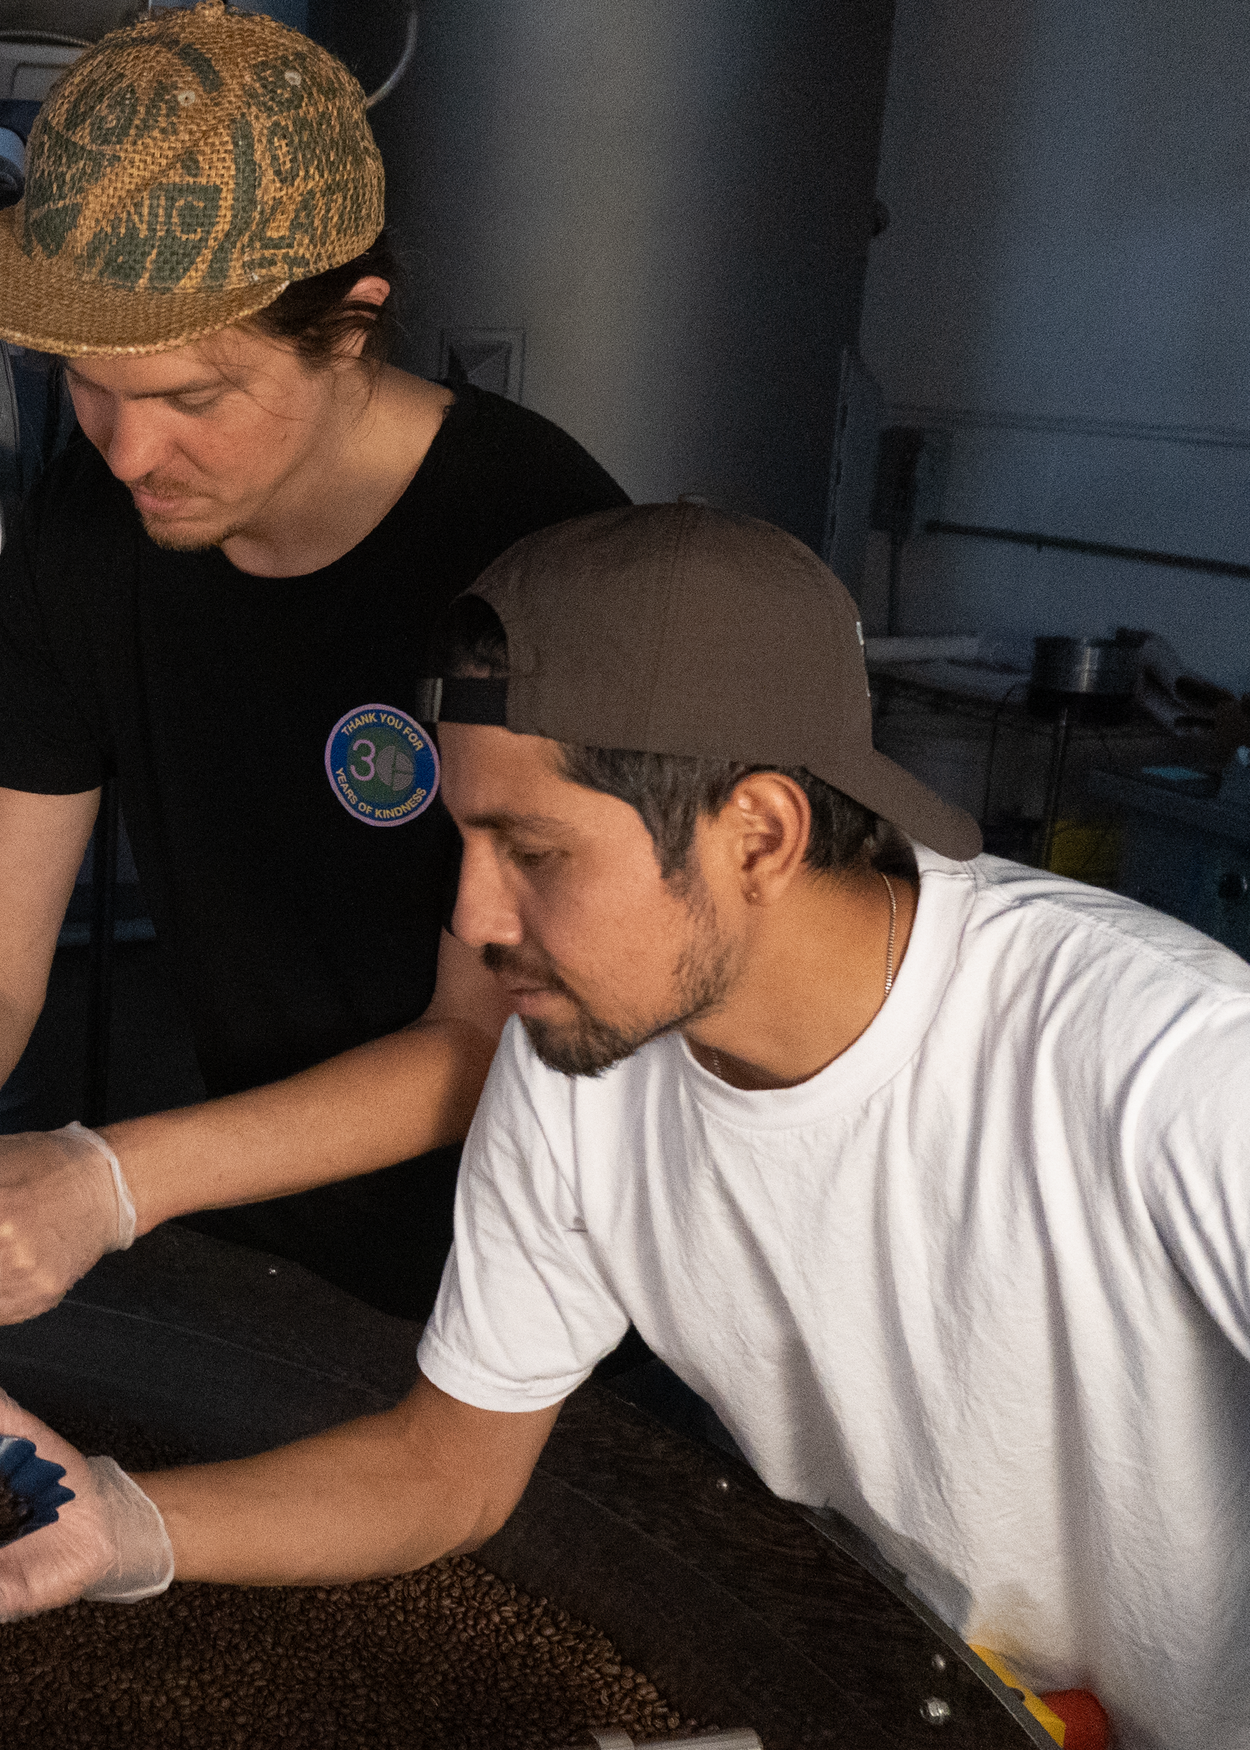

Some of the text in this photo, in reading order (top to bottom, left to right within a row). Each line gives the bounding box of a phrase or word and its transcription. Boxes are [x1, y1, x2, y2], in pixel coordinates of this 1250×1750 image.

[341, 713, 425, 751] THANK YOU FOR
[335, 767, 427, 819] YEARS OF KINDNESS
